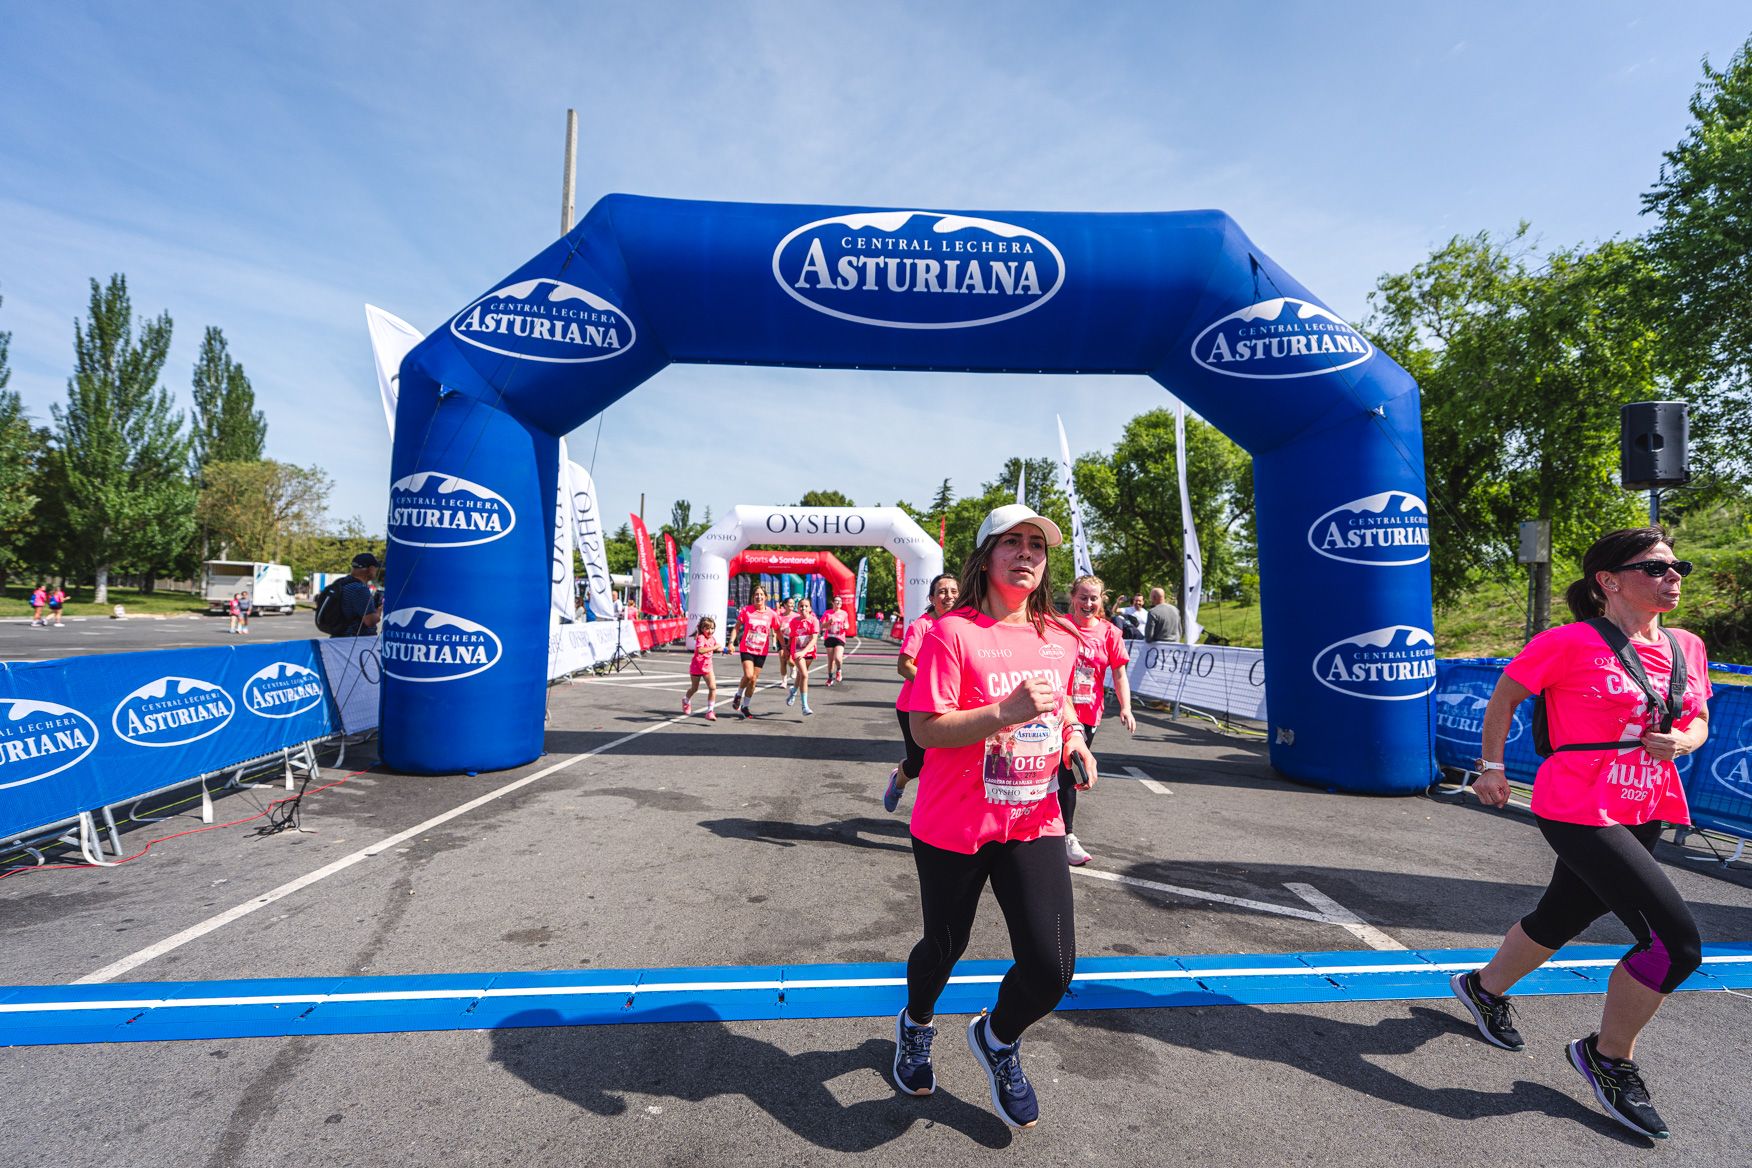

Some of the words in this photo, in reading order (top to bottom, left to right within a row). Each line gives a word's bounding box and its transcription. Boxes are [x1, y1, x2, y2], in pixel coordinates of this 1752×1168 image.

[841, 236, 932, 251] CENTRAL
[942, 240, 1034, 253] LECHERA
[794, 237, 1042, 295] ASTURIANA
[490, 302, 546, 314] CENTRAL
[552, 307, 616, 324] LECHERA
[457, 305, 621, 349] ASTURIANA
[1238, 323, 1300, 337] CENTRAL
[1206, 332, 1367, 363] ASTURIANA
[396, 497, 437, 506] CENTRAL
[441, 498, 499, 510] LECHERA
[766, 513, 865, 535] OYSHO
[1348, 517, 1402, 526] CENTRAL
[706, 533, 737, 542] OYSHO
[1320, 521, 1430, 549] ASTURIAN
[745, 555, 769, 565] Sports
[779, 556, 816, 564] Santander
[385, 630, 423, 640] CENTRAL
[428, 633, 485, 643] LECHERA
[382, 641, 488, 665] STURIANA
[977, 648, 1013, 658] OYSHO
[1353, 651, 1407, 660] CENTRAL
[1144, 647, 1215, 678] OYSHO
[1326, 653, 1437, 682] ASTURIAN
[141, 699, 183, 712] CENTRAL
[19, 717, 77, 734] LECHERA
[127, 700, 230, 737] ASTURIANA
[1014, 756, 1046, 771] 016
[991, 787, 1021, 796] OYSHO
